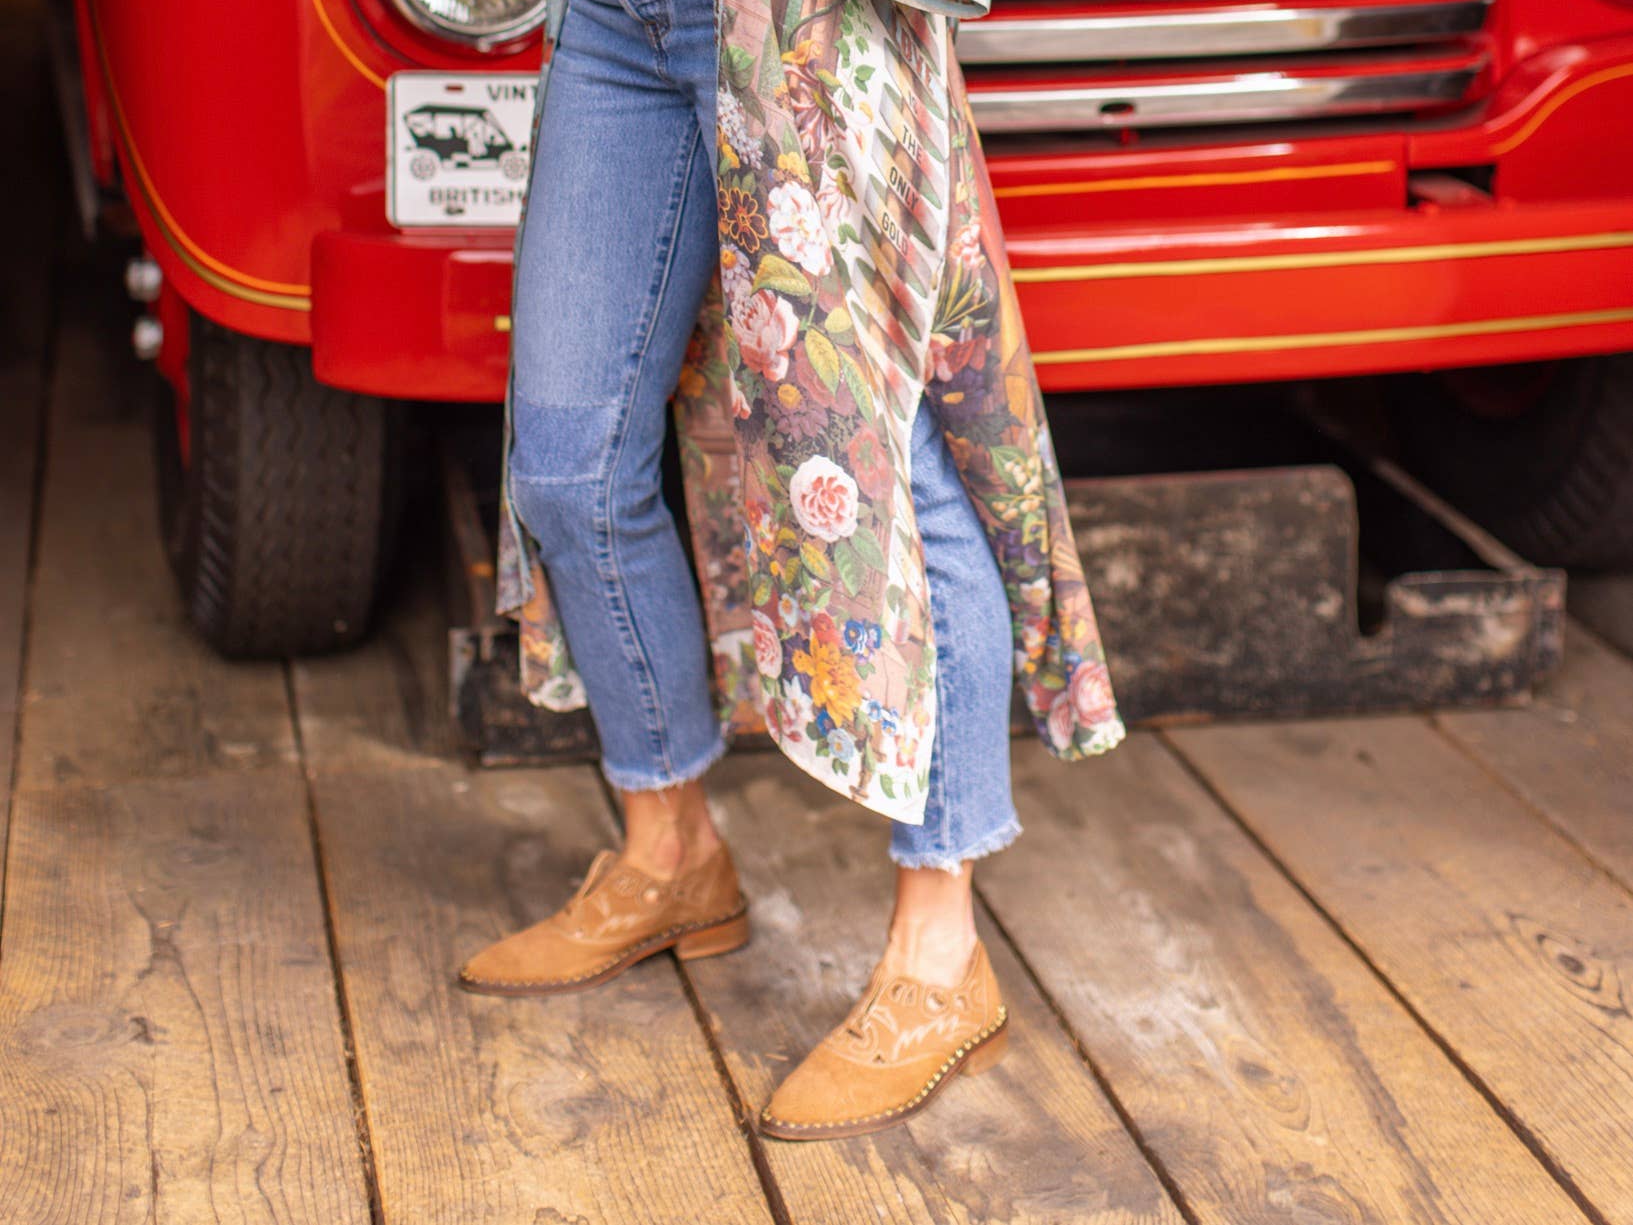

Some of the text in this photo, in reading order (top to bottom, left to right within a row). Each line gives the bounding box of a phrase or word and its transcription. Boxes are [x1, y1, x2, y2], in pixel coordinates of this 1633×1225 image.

[901, 124, 923, 166] THE
[889, 166, 920, 210] ONLY
[881, 212, 909, 256] GOLD
